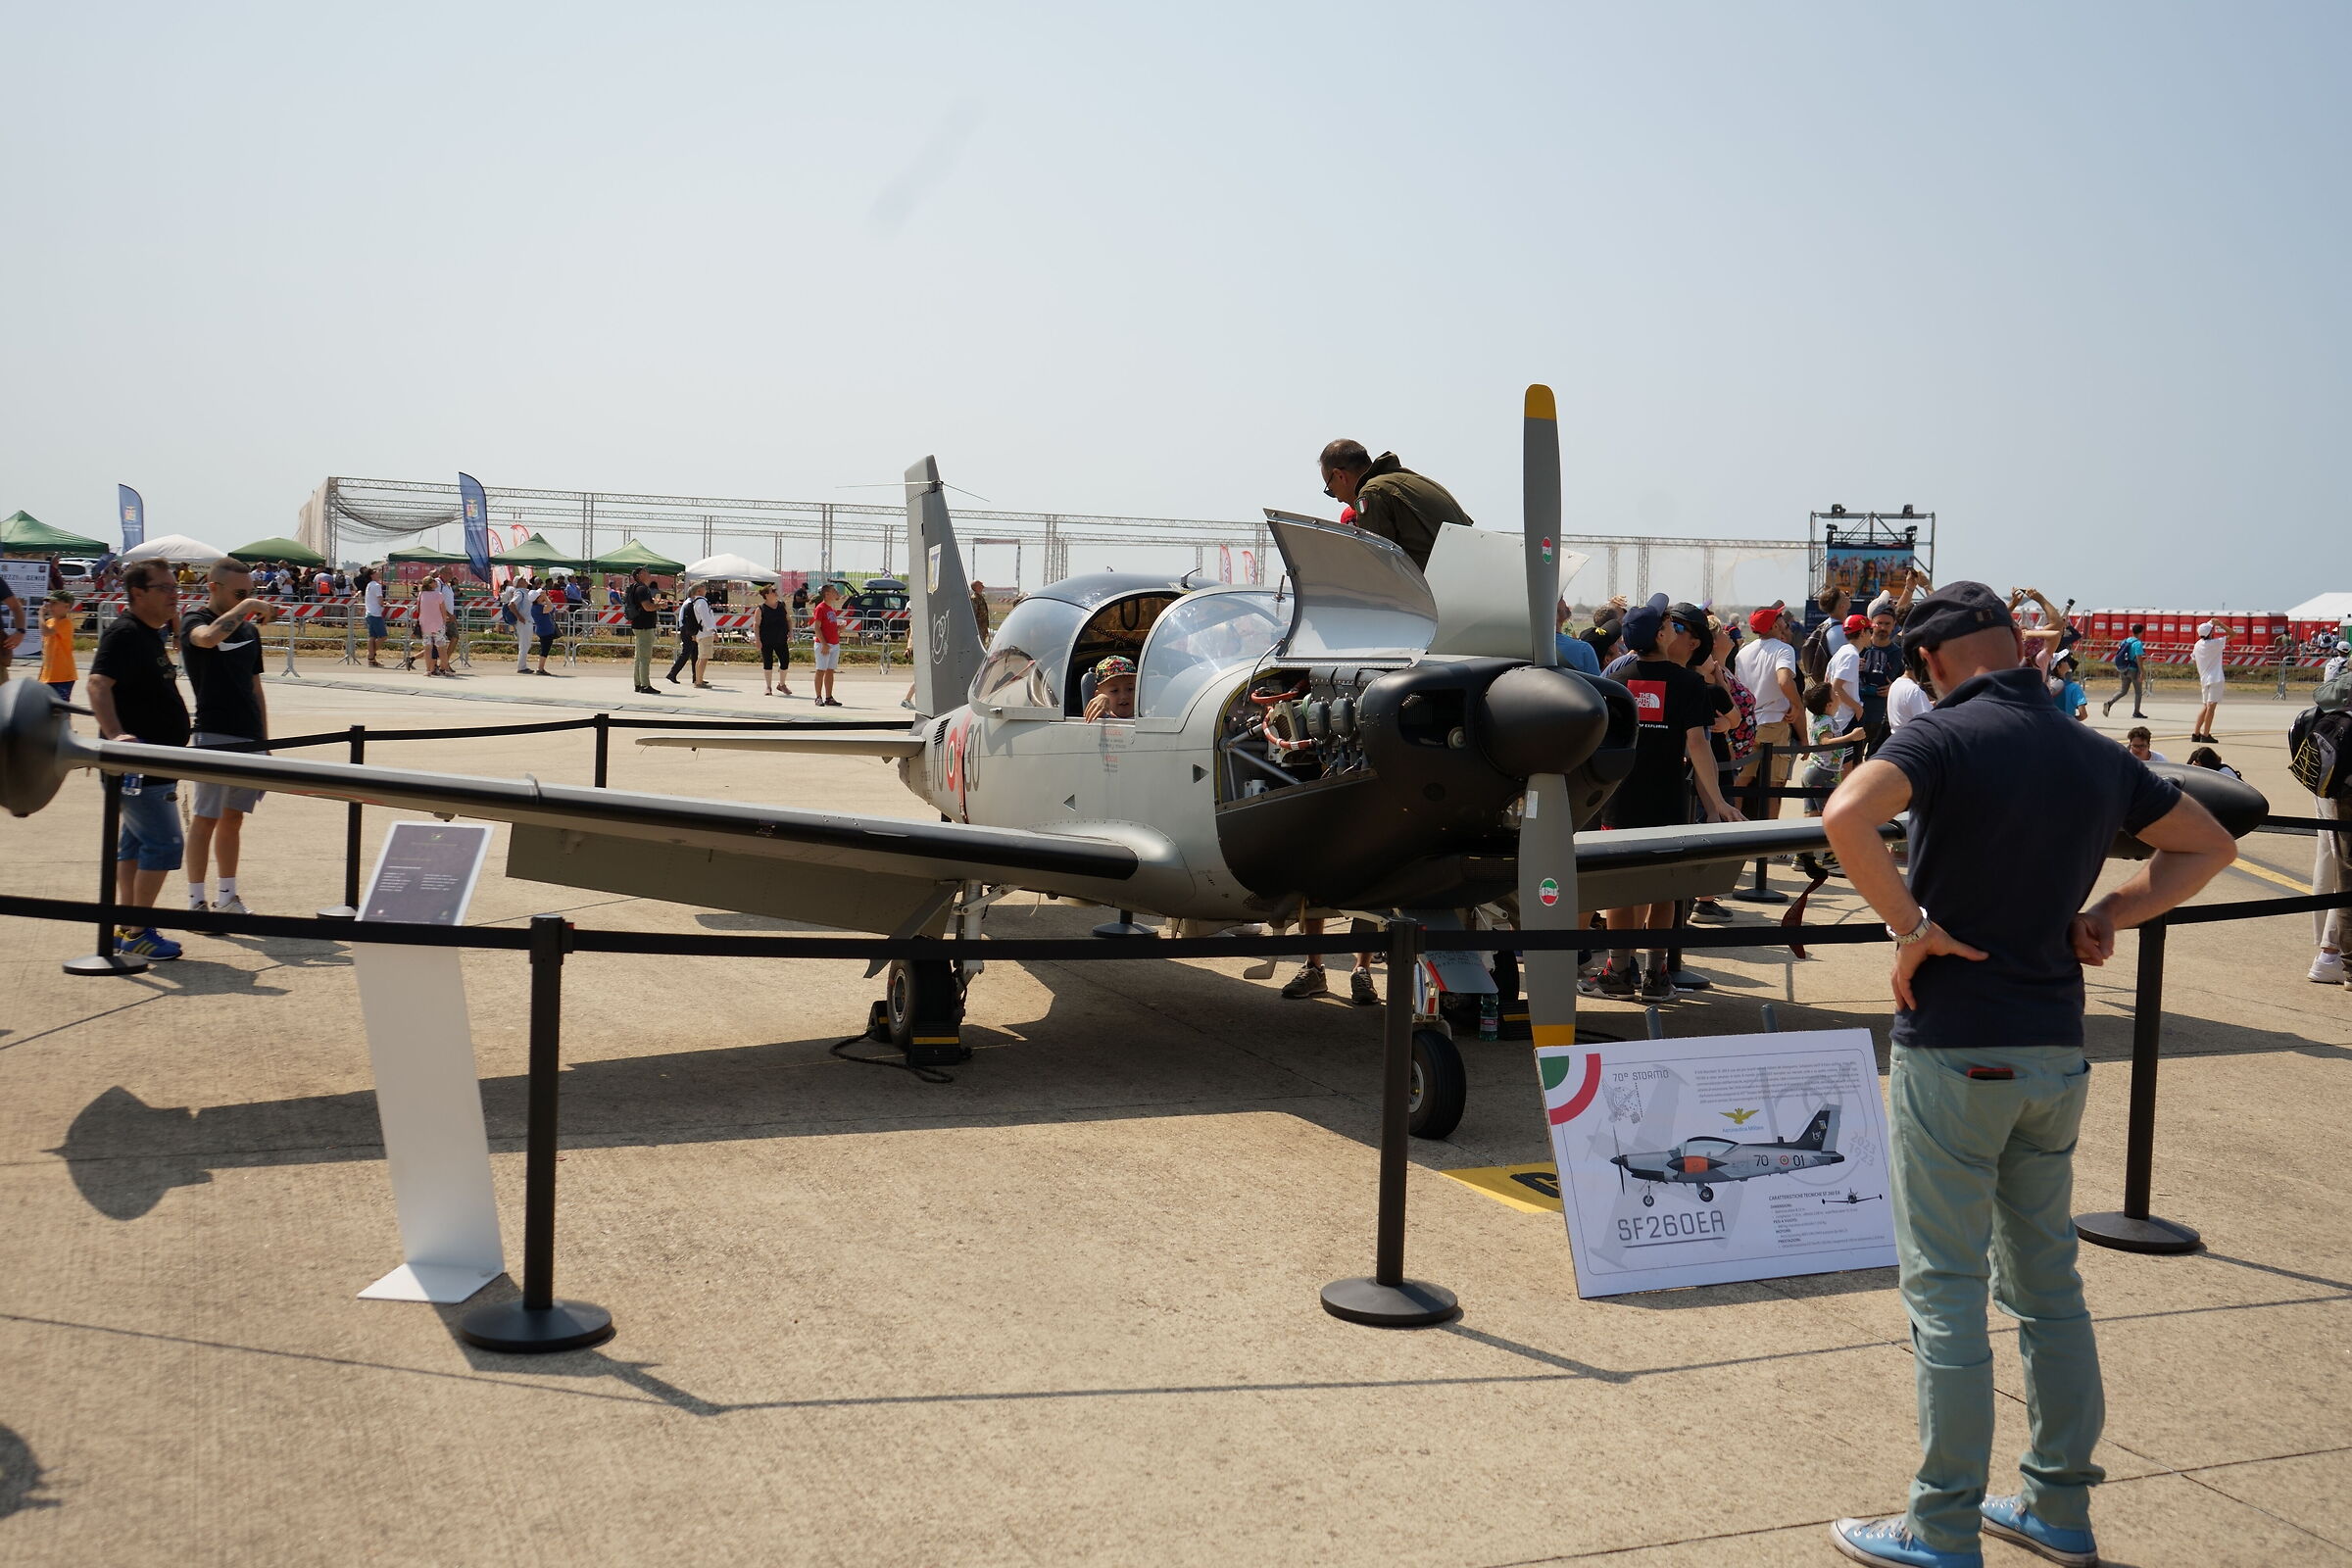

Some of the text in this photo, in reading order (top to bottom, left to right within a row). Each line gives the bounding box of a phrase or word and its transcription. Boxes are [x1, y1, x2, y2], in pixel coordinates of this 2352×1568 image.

[963, 722, 981, 792] 30
[1632, 1069, 1669, 1081] STORMO
[1753, 1154, 1769, 1166] 70
[1792, 1154, 1805, 1166] 01
[1617, 1210, 1725, 1241] SF260EA
